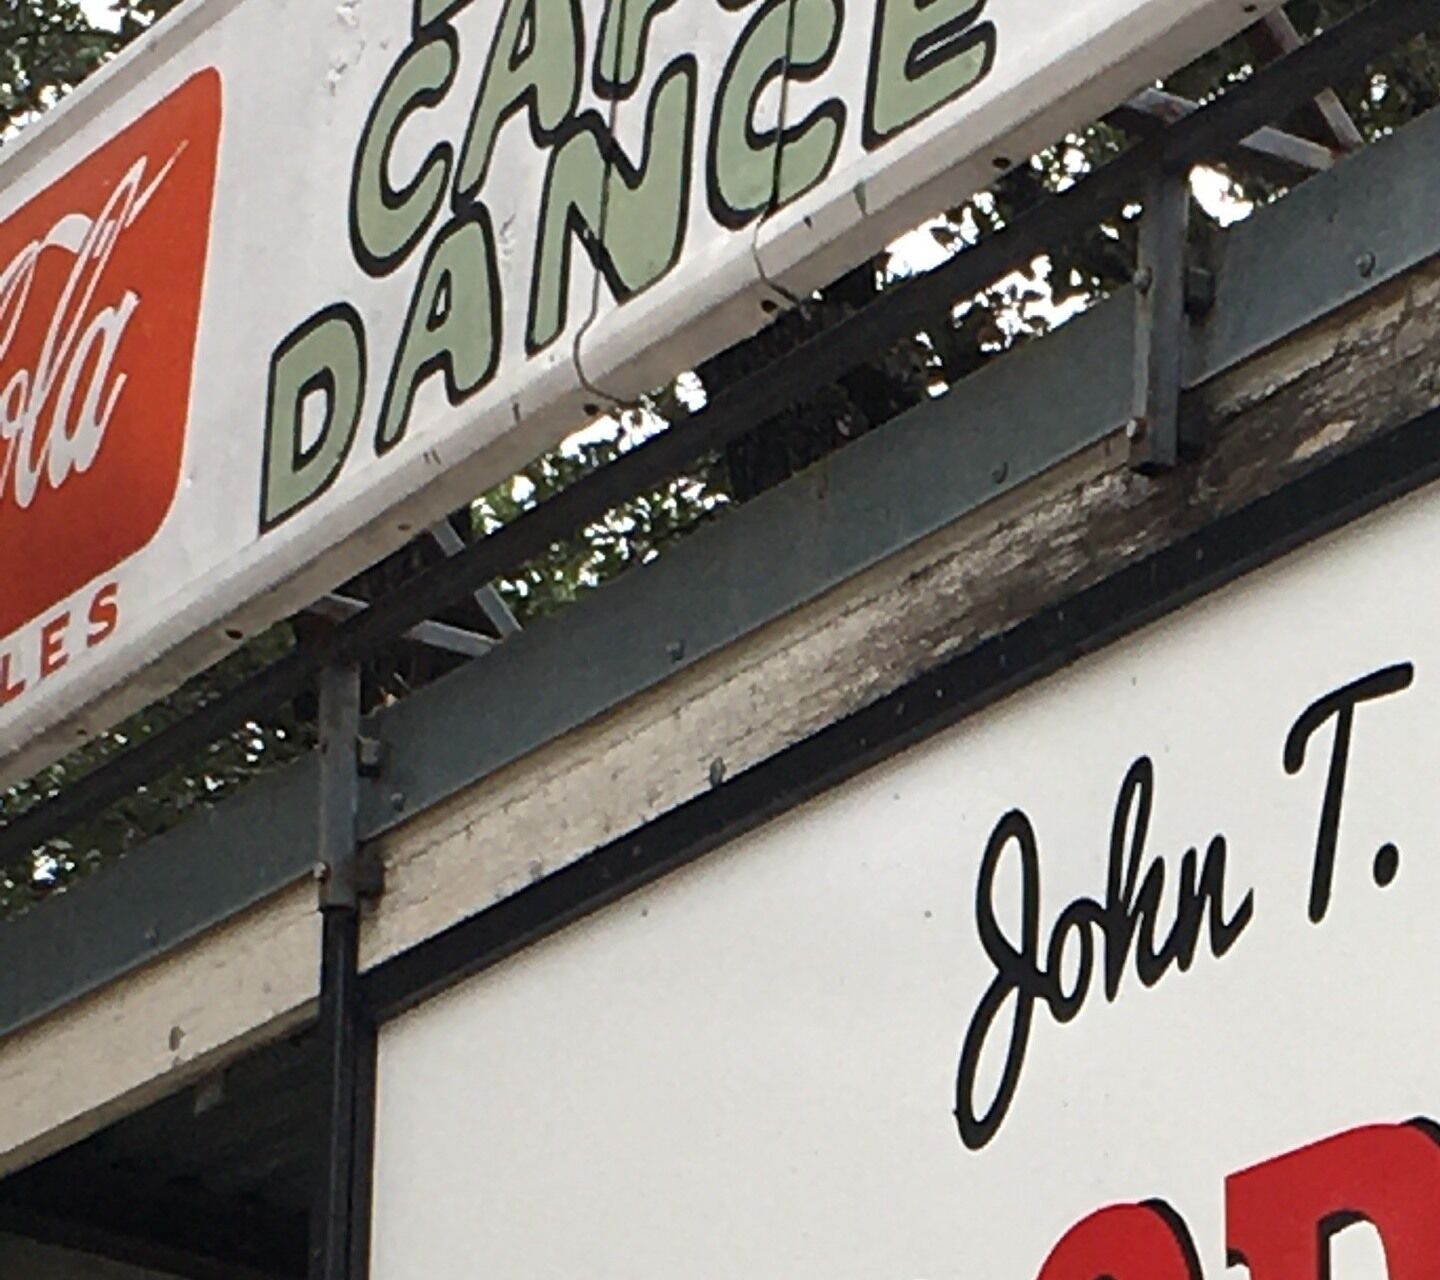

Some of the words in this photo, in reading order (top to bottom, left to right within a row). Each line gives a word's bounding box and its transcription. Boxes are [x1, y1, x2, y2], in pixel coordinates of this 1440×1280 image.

[258, 0, 997, 533] DANCE
[954, 756, 1253, 1150] John
[1284, 663, 1413, 923] T.
